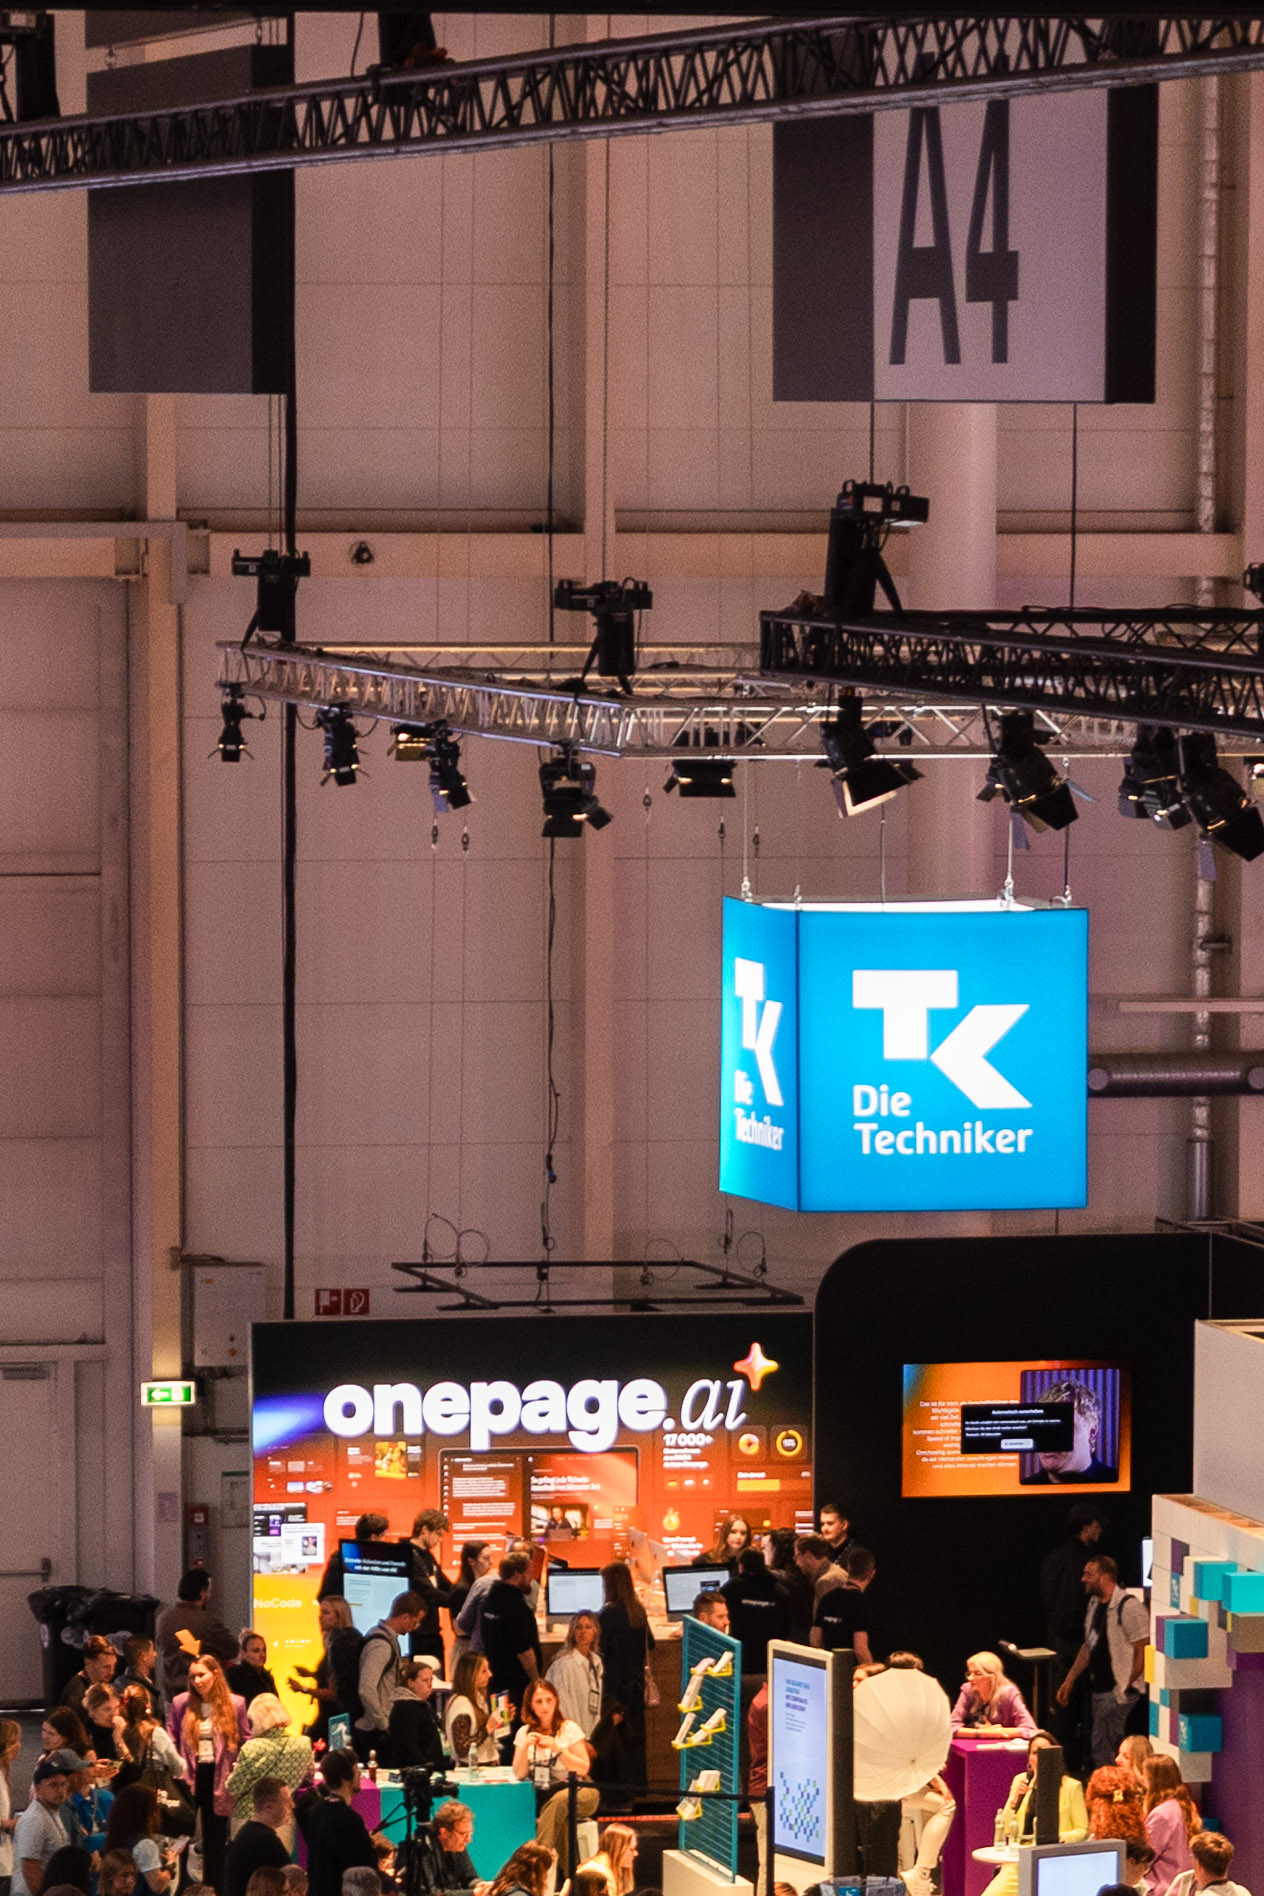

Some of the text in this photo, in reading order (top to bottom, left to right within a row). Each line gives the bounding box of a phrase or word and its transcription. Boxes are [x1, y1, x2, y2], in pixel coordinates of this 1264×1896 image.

[889, 52, 1018, 364] A4
[735, 957, 783, 1107] TK
[852, 970, 1033, 1109] TK
[735, 1070, 754, 1103] Die
[853, 1084, 911, 1118] Die
[735, 1111, 784, 1151] Techniker
[854, 1122, 1033, 1155] Techniker
[323, 1378, 748, 1452] onepage.ai
[253, 1598, 302, 1609] NoCode
